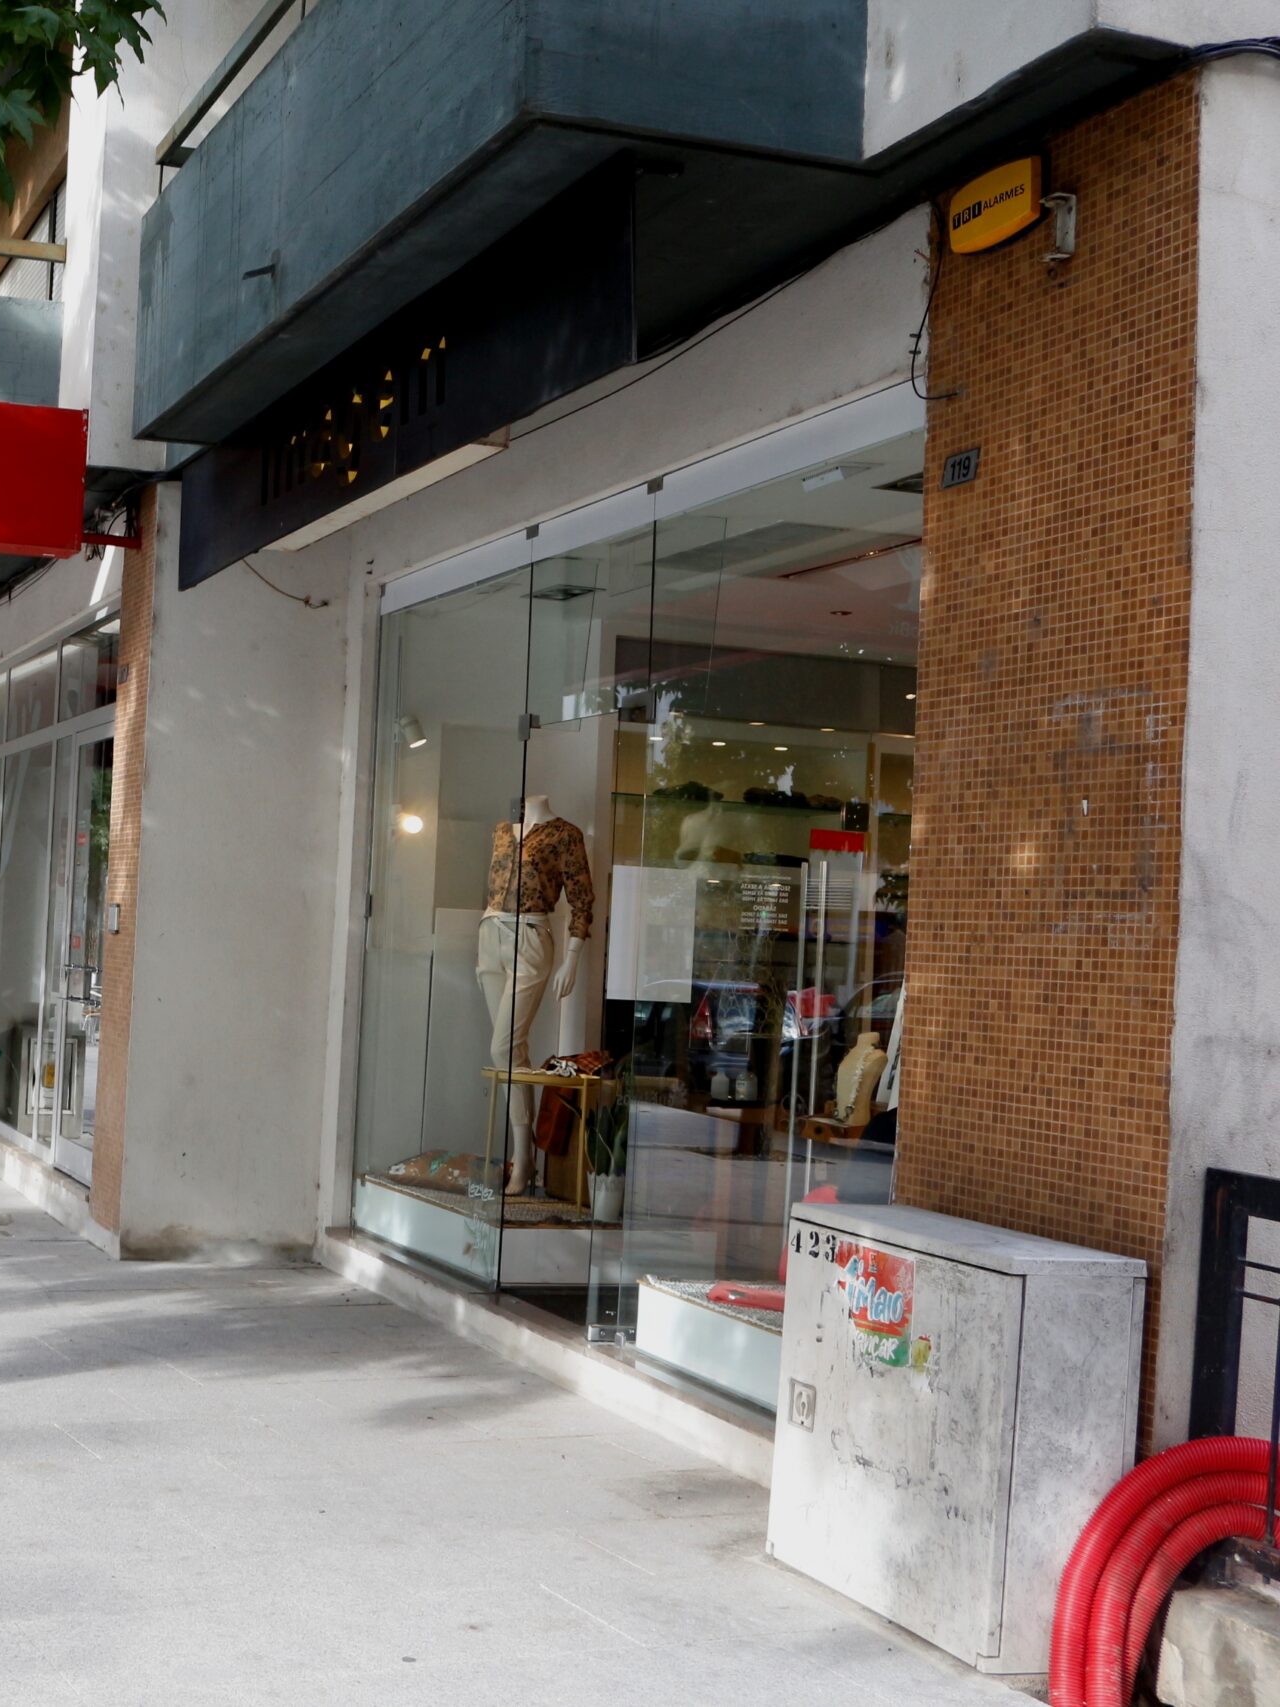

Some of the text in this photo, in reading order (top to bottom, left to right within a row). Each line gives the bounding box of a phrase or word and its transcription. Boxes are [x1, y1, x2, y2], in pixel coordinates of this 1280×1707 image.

[953, 182, 1025, 230] TRI ALARMES
[950, 455, 971, 482] 119
[791, 1229, 836, 1264] 423
